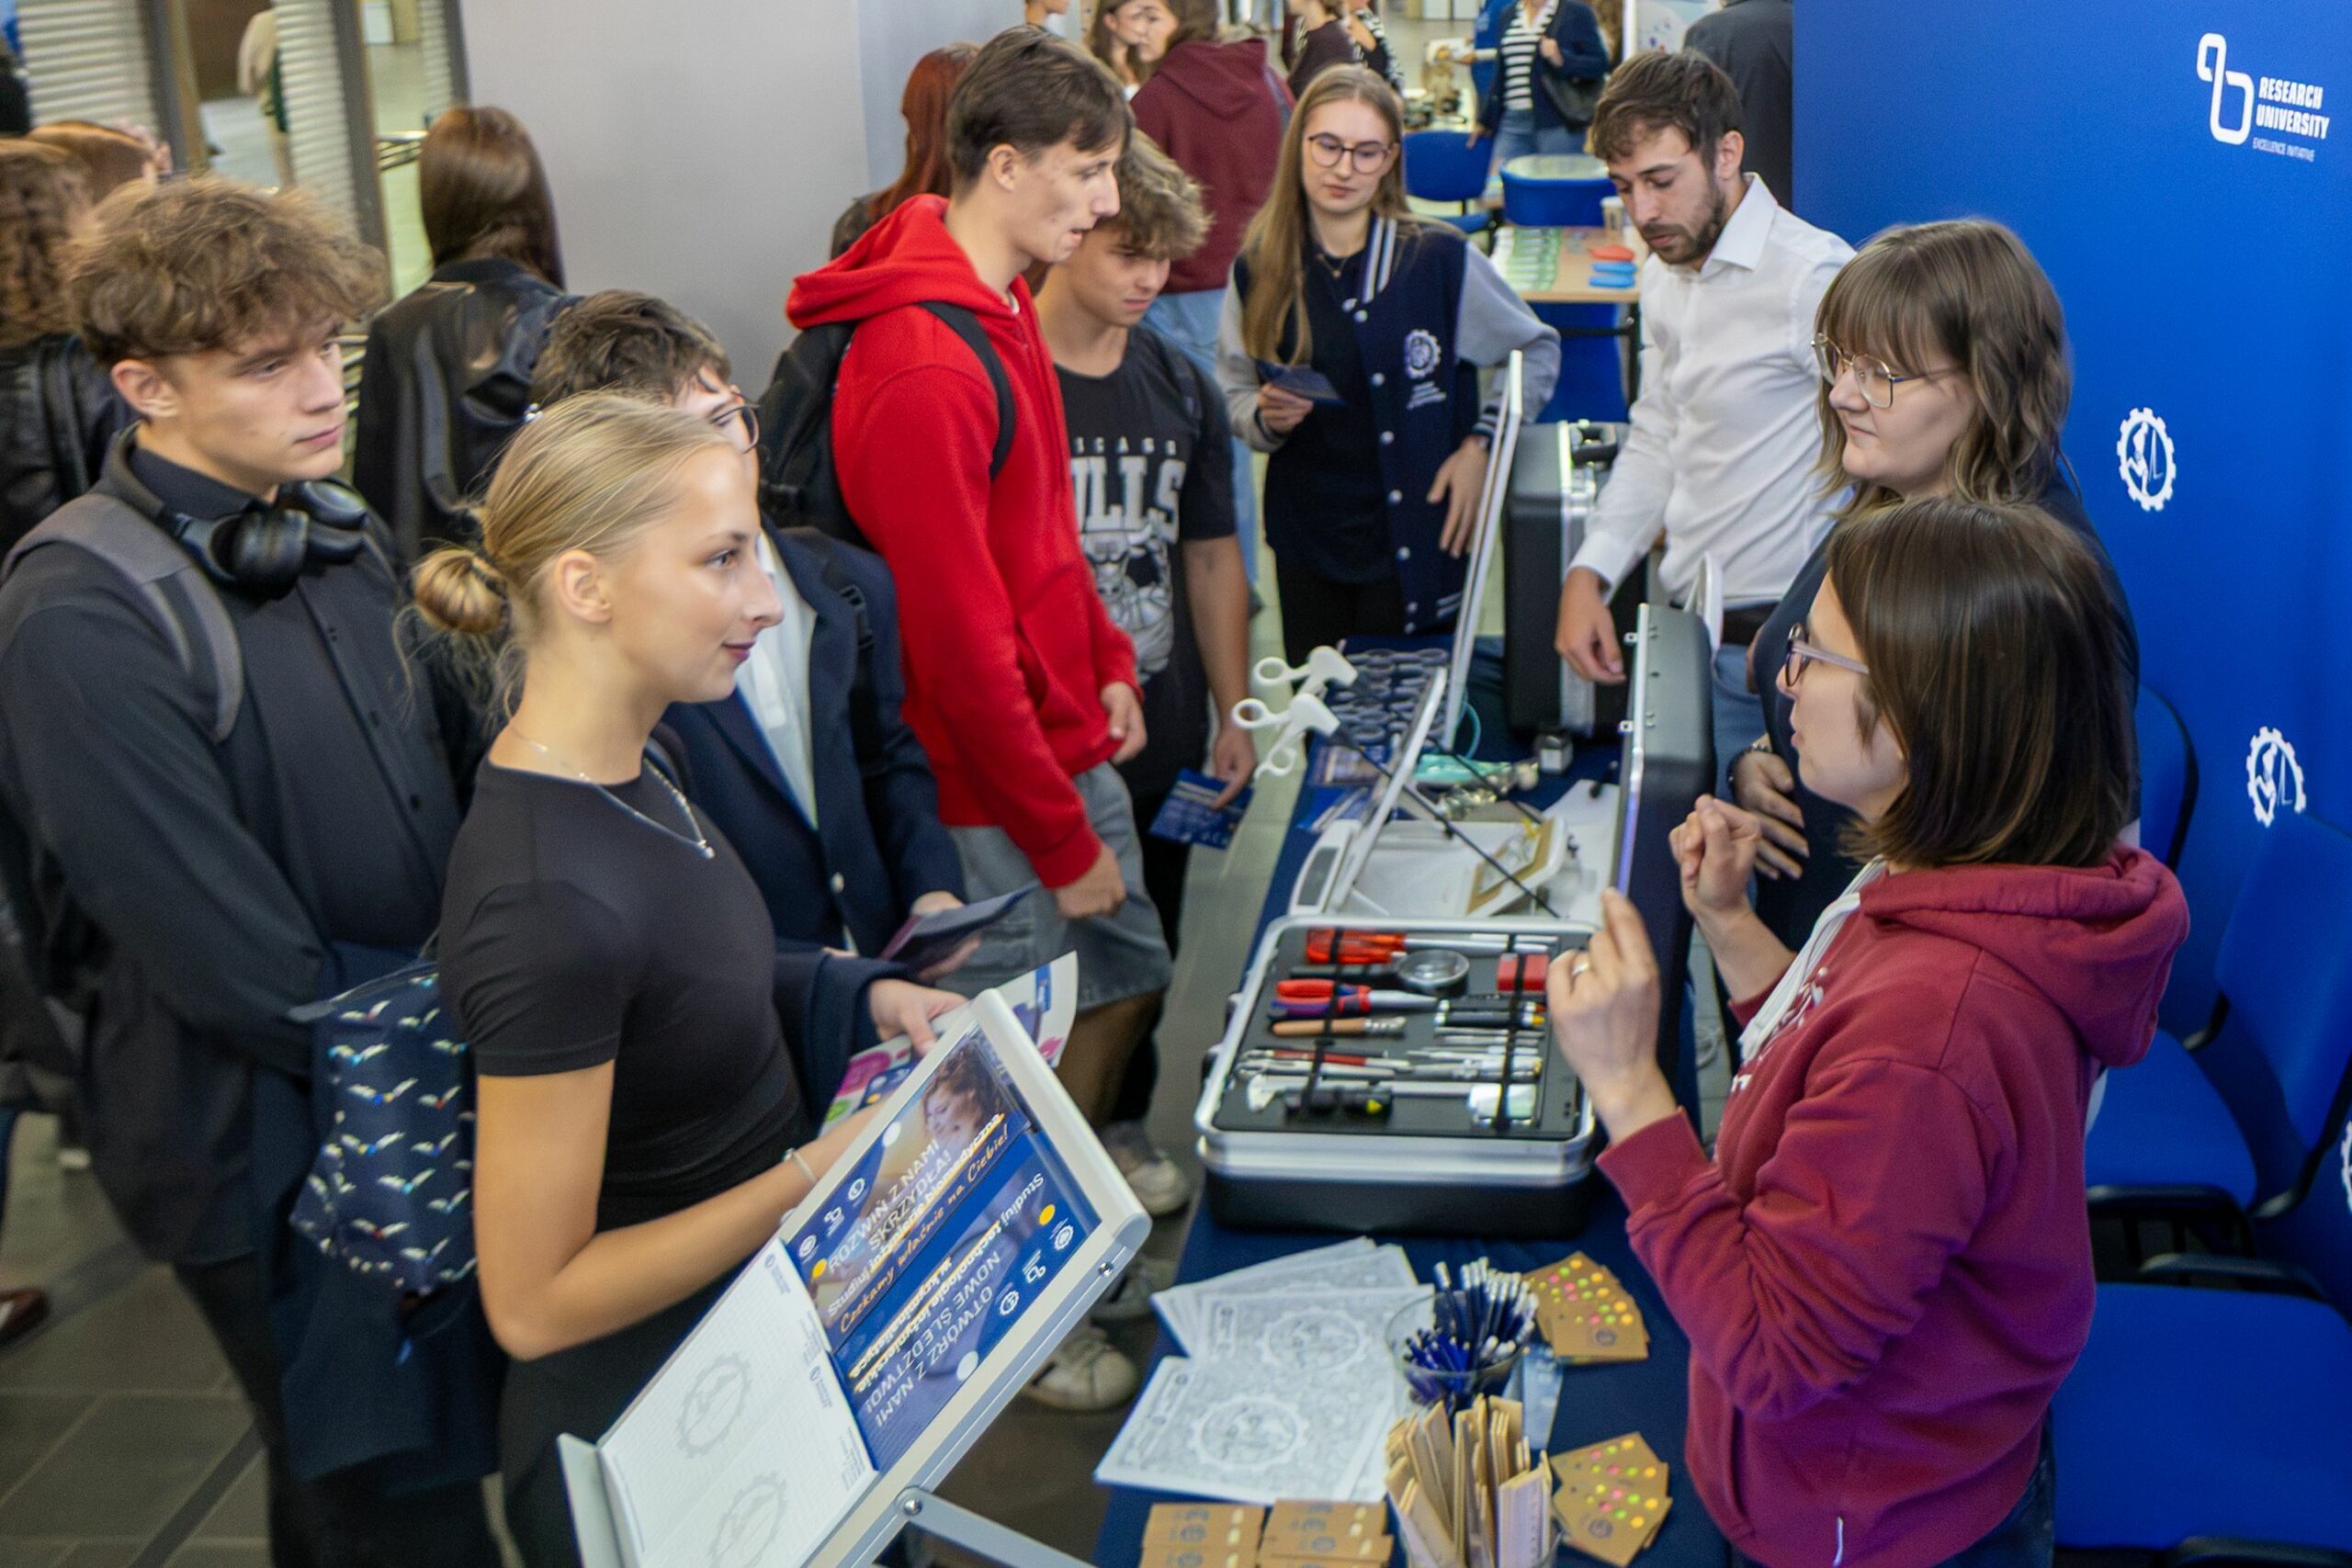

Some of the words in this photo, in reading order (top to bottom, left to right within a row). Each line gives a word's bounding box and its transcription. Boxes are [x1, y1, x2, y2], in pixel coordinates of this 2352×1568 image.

[2256, 103, 2330, 140] UNIVERSITY
[2258, 76, 2324, 109] RESEARCH
[825, 1196, 889, 1274] ROZWIŃ
[888, 1183, 902, 1201] Z
[899, 1136, 941, 1187] NAMI
[839, 1264, 897, 1335] Czekamy
[945, 1183, 965, 1206] na
[966, 1122, 1009, 1183] Ciebie!
[868, 1148, 952, 1252] SKRZYDŁA!
[999, 1171, 1044, 1226] Studiuj
[826, 1265, 870, 1317] Studiuj
[928, 1220, 1001, 1309] technologie
[936, 1258, 953, 1276] w
[951, 1248, 1000, 1310] NOWE
[849, 1271, 942, 1380] kryminalistyce
[855, 1305, 932, 1395] inżynierskie
[864, 1305, 953, 1414] ŚLEDZTWO!
[925, 1283, 994, 1365] OTWÓRZ
[874, 1375, 914, 1427] NAMI
[913, 1359, 929, 1381] Z
